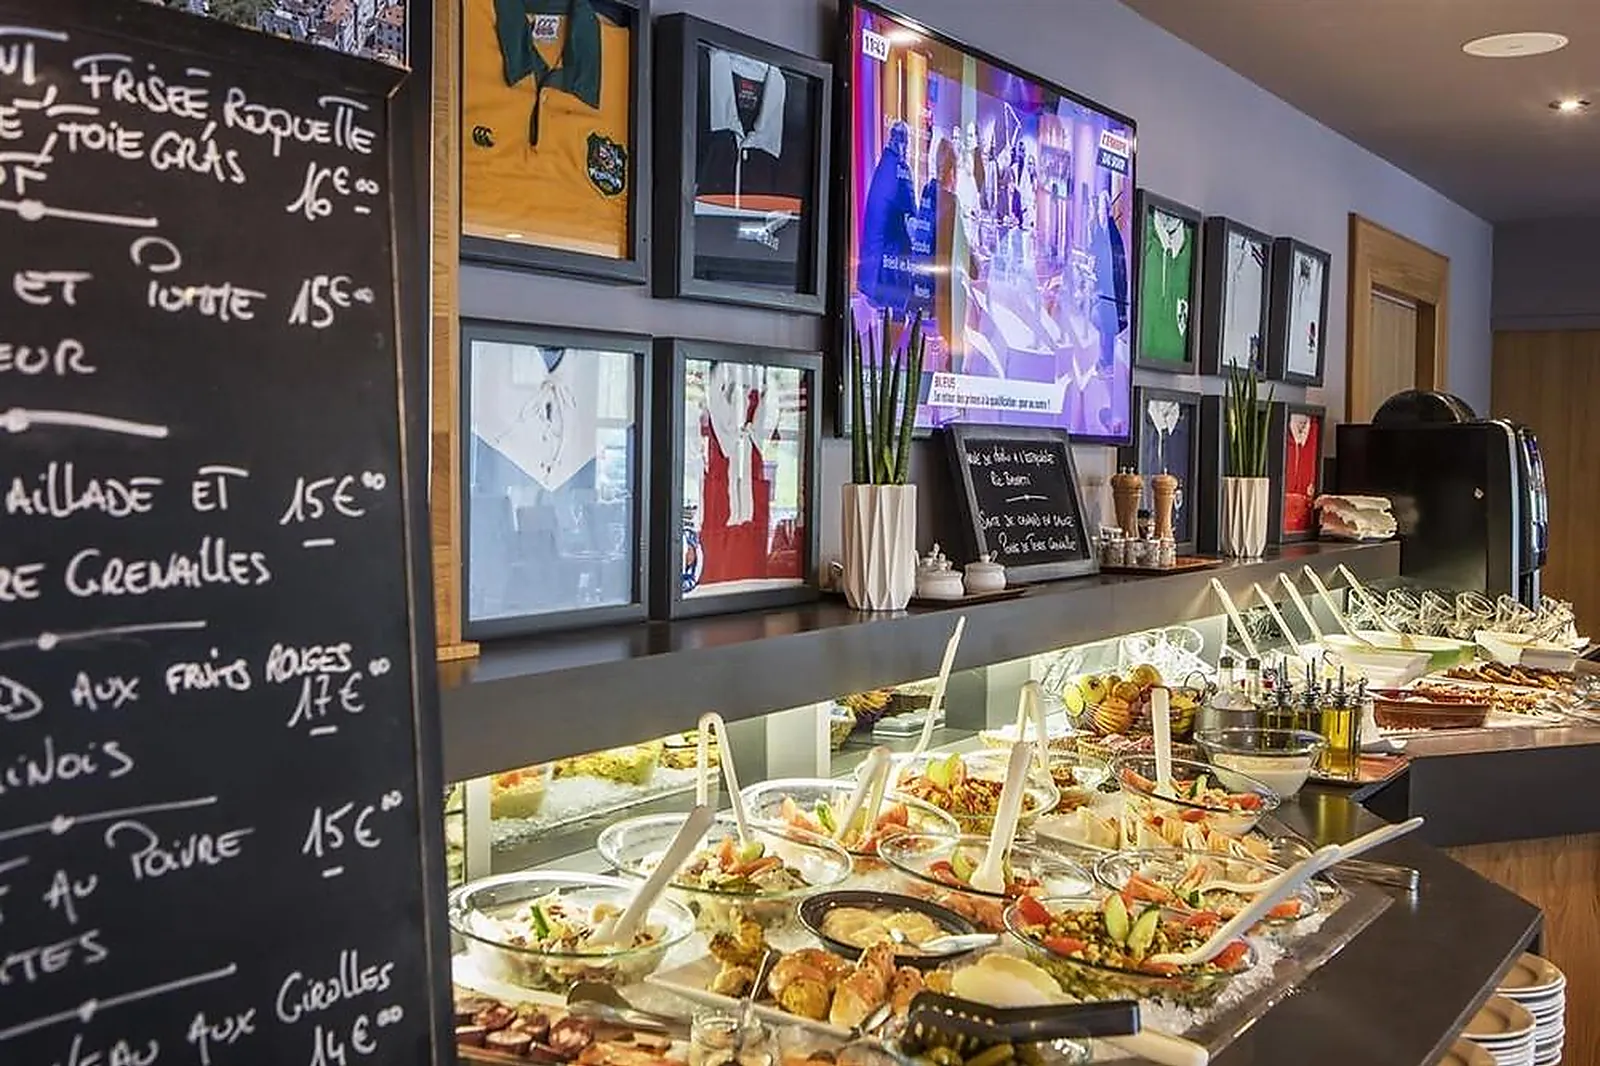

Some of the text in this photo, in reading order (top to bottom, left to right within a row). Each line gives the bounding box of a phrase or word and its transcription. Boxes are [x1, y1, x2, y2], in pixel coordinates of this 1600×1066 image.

[13, 270, 94, 305] ET
[192, 466, 249, 511] ET
[72, 671, 139, 711] AUX
[266, 643, 352, 682] ROUGES
[0, 736, 133, 796] INOIS
